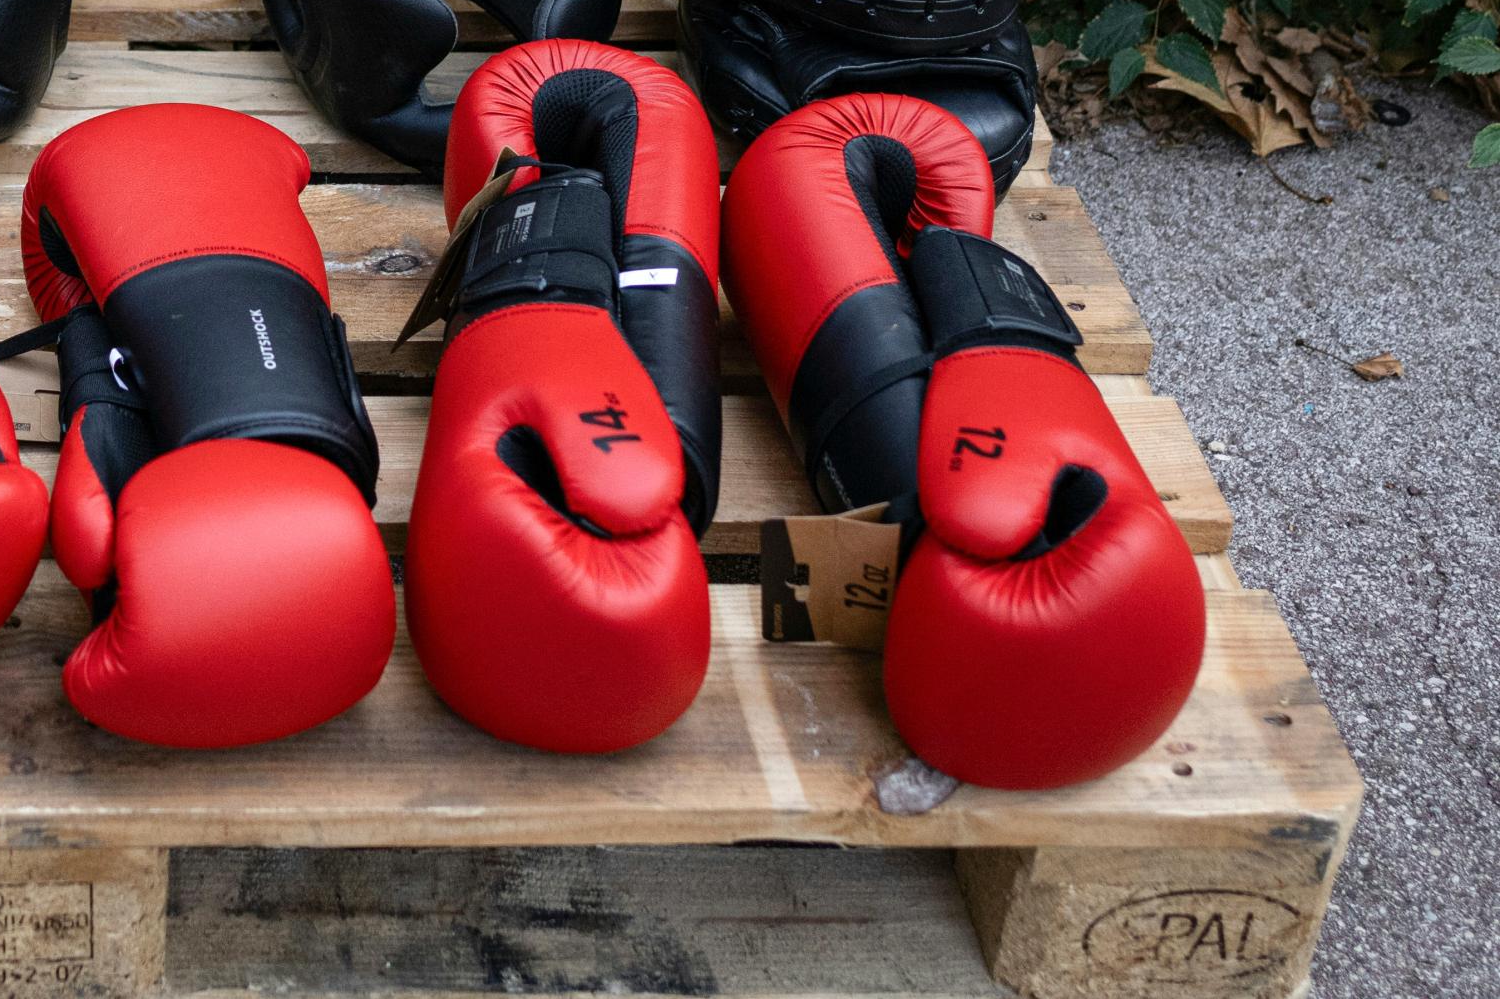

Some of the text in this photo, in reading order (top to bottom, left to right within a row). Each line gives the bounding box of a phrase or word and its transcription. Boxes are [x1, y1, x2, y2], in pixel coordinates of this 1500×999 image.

[249, 308, 277, 370] OUTSHOCK
[579, 406, 642, 454] 14
[953, 427, 1006, 459] 12
[843, 582, 888, 610] 12
